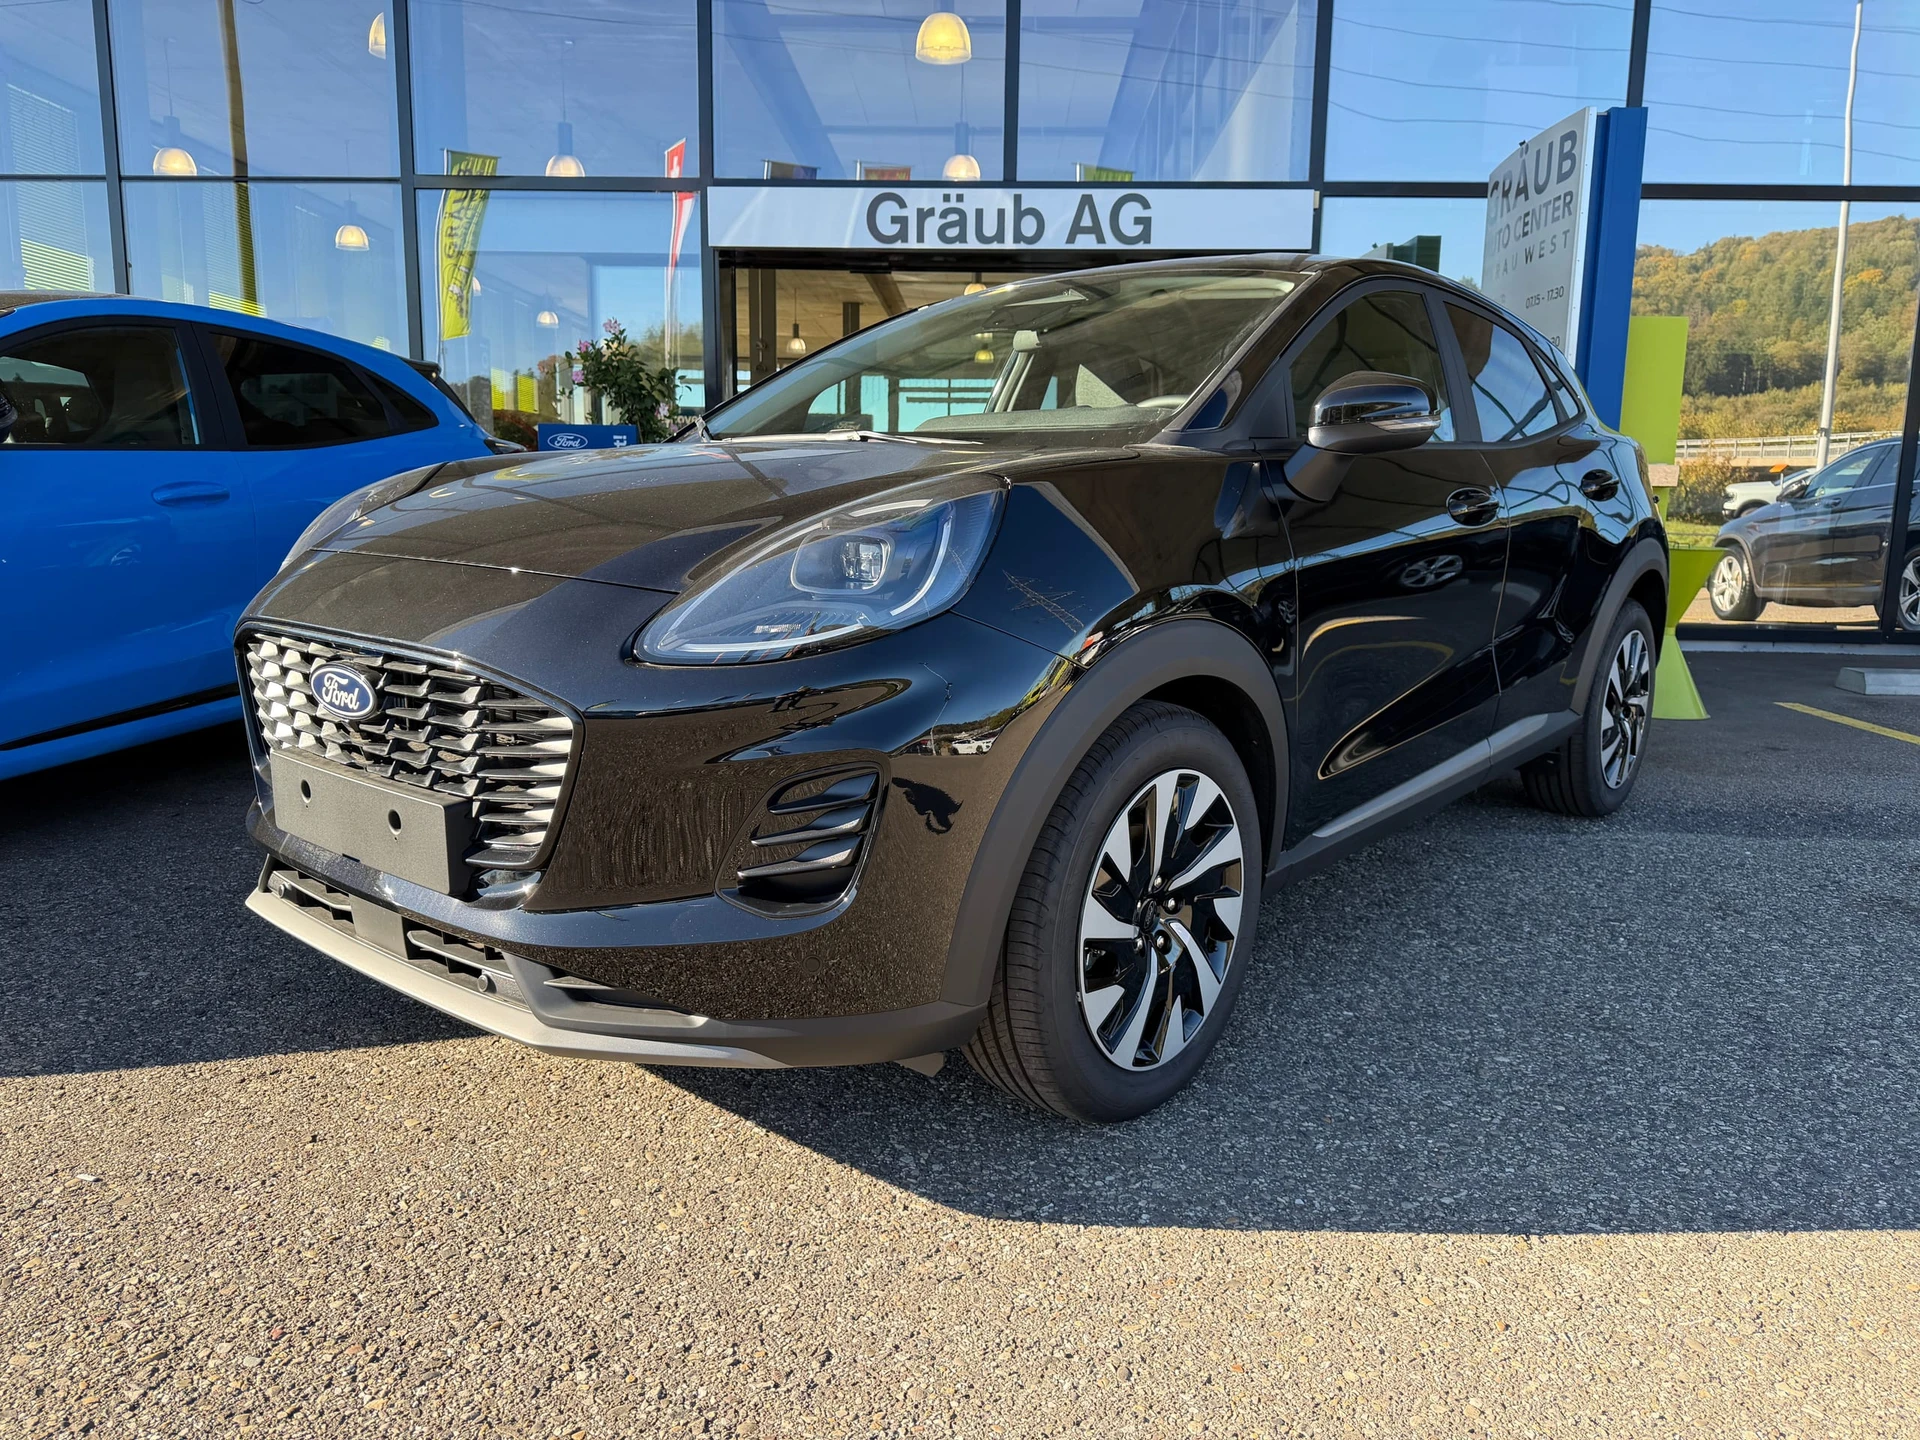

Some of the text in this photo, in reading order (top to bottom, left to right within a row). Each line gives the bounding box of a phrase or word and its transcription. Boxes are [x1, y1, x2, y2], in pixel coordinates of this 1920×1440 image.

[866, 191, 1152, 245] Gräub AG
[1524, 228, 1570, 265] WEST
[321, 672, 360, 711] Ford
